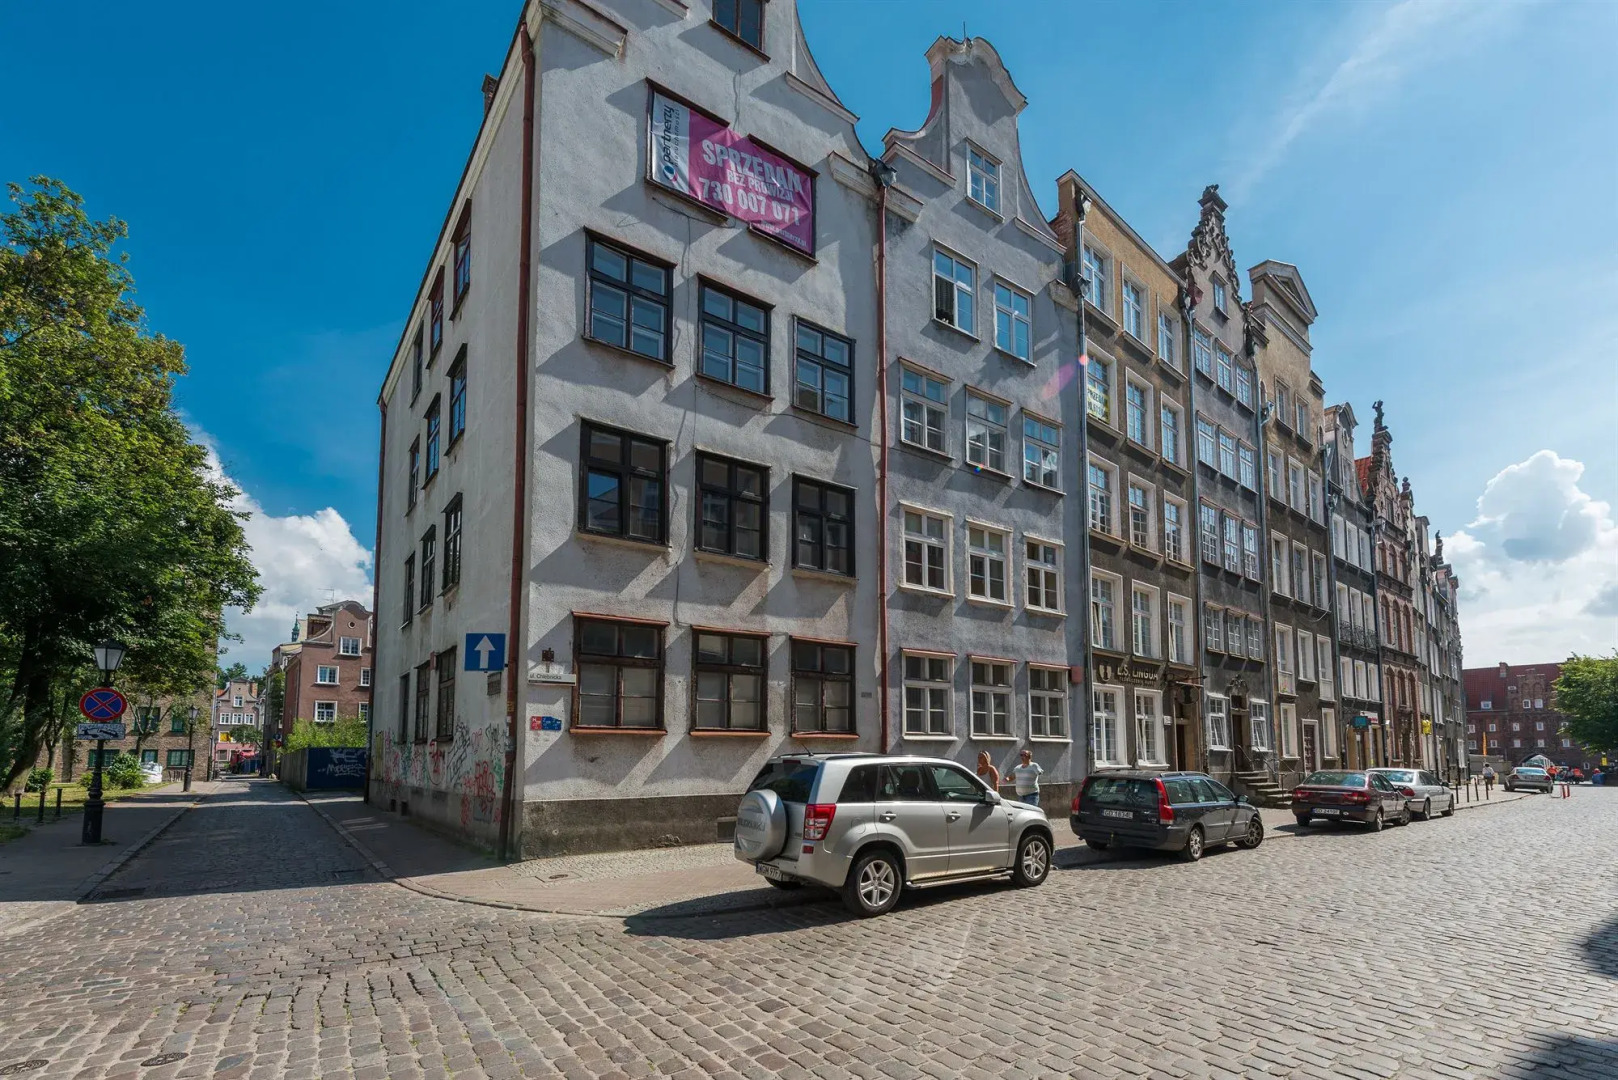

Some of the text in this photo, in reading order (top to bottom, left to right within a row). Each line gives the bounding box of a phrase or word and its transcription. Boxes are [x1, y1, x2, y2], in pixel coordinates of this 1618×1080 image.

[661, 105, 675, 165] partnerzy
[702, 139, 803, 194] SPRZEDAM
[726, 168, 746, 188] BEZ
[699, 177, 801, 226] 730 007 071
[1132, 667, 1159, 681] LINGUA
